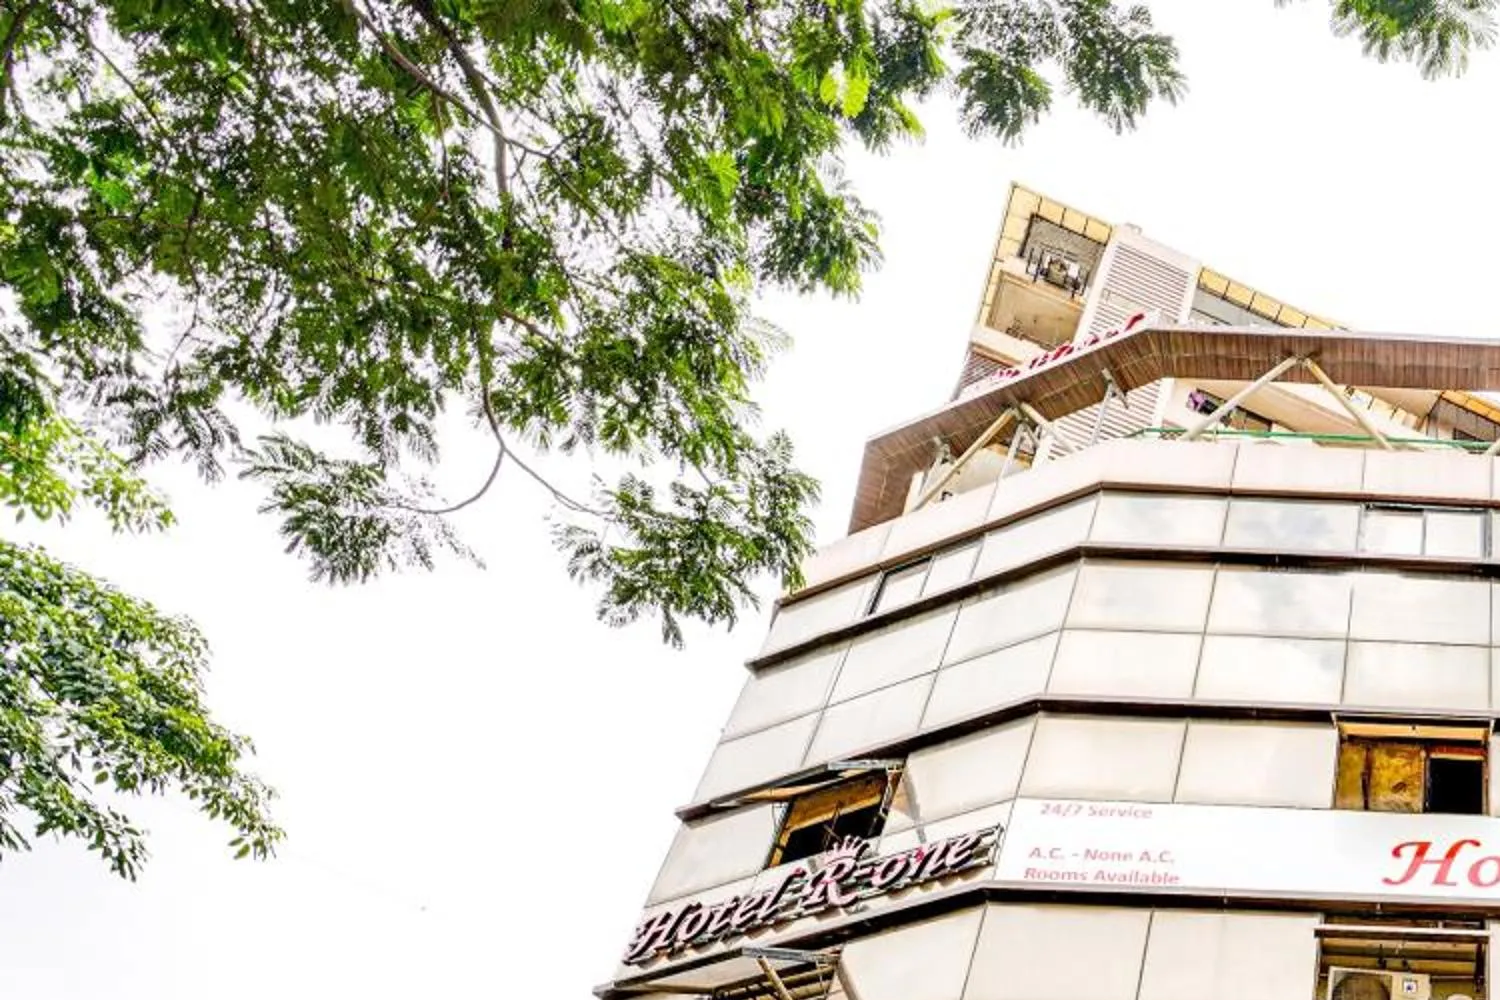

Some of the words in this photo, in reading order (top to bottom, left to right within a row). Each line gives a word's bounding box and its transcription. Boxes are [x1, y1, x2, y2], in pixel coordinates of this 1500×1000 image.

[1040, 803, 1082, 817] 24/7
[1088, 805, 1153, 819] Service
[1024, 867, 1088, 881] Rooms
[1093, 870, 1181, 885] Available
[623, 867, 800, 966] Hotel
[802, 830, 1004, 909] R-one
